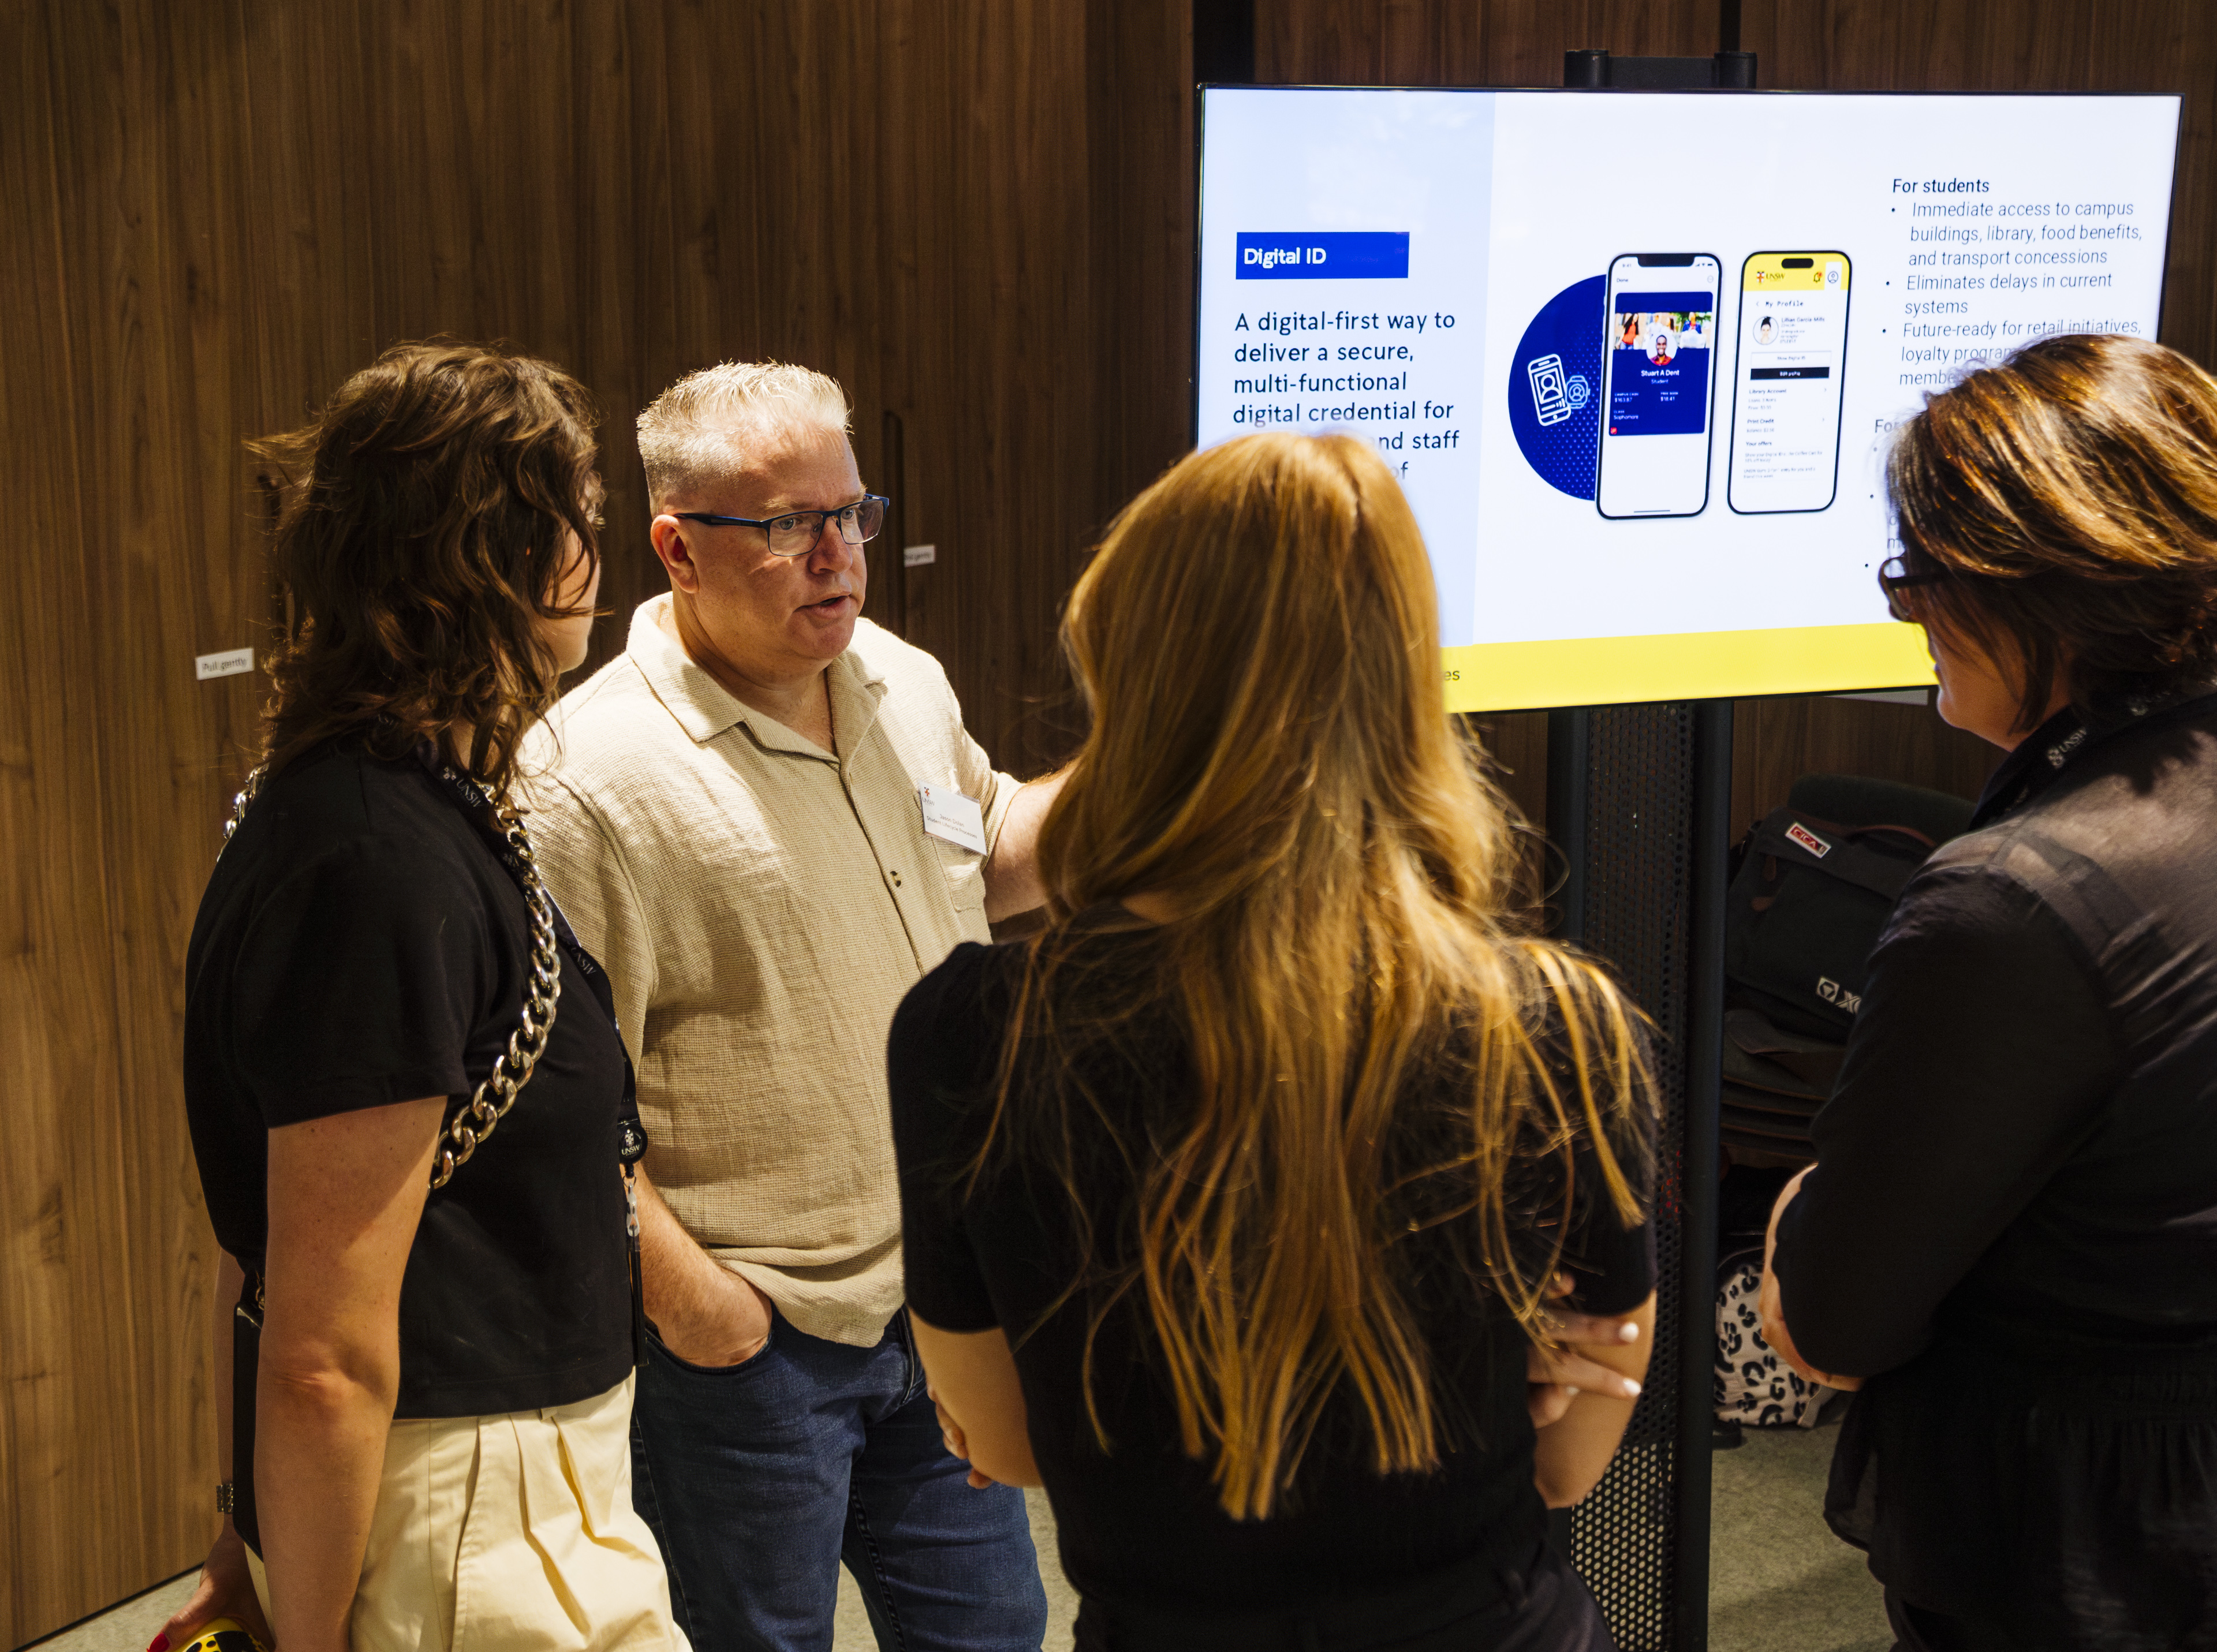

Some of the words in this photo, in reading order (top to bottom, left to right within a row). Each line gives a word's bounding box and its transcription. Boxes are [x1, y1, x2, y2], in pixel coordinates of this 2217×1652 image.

[1893, 178, 1919, 193] For
[1923, 177, 1990, 193] students
[1913, 201, 1994, 217] Immediate
[1998, 204, 2051, 216] access
[2056, 202, 2070, 216] to
[2075, 203, 2133, 219] campus
[1910, 226, 1983, 244] buildings,
[1987, 225, 2036, 243] library,
[2041, 225, 2076, 240] food
[2080, 224, 2143, 241] benefits,
[1244, 246, 1301, 269] Digital
[1306, 247, 1327, 264] ID
[1909, 250, 1936, 266] and
[1942, 251, 2010, 269] transport
[2014, 248, 2108, 264] concessions
[1907, 275, 1985, 290] Eliminates
[1990, 272, 2037, 292] delays
[2043, 273, 2055, 287] in
[2060, 272, 2112, 287] current
[1905, 300, 1968, 318] systems
[1234, 312, 1250, 331] A
[1257, 310, 1380, 336] digital-first
[1387, 314, 1428, 334] way
[1434, 312, 1455, 328] to
[1904, 320, 1997, 340] Future-ready
[2002, 320, 2023, 335] for
[2028, 319, 2063, 334] retail
[1234, 342, 1310, 362] deliver
[1317, 347, 1328, 361] a
[1337, 345, 1414, 362] secure,
[1902, 346, 1950, 365] loyalty
[1234, 371, 1407, 394] multi-functional
[1233, 403, 1300, 428] digital
[1308, 400, 1416, 422] credential
[1423, 399, 1455, 419] for
[1412, 429, 1460, 449] staff
[621, 1144, 640, 1156] UNSW
